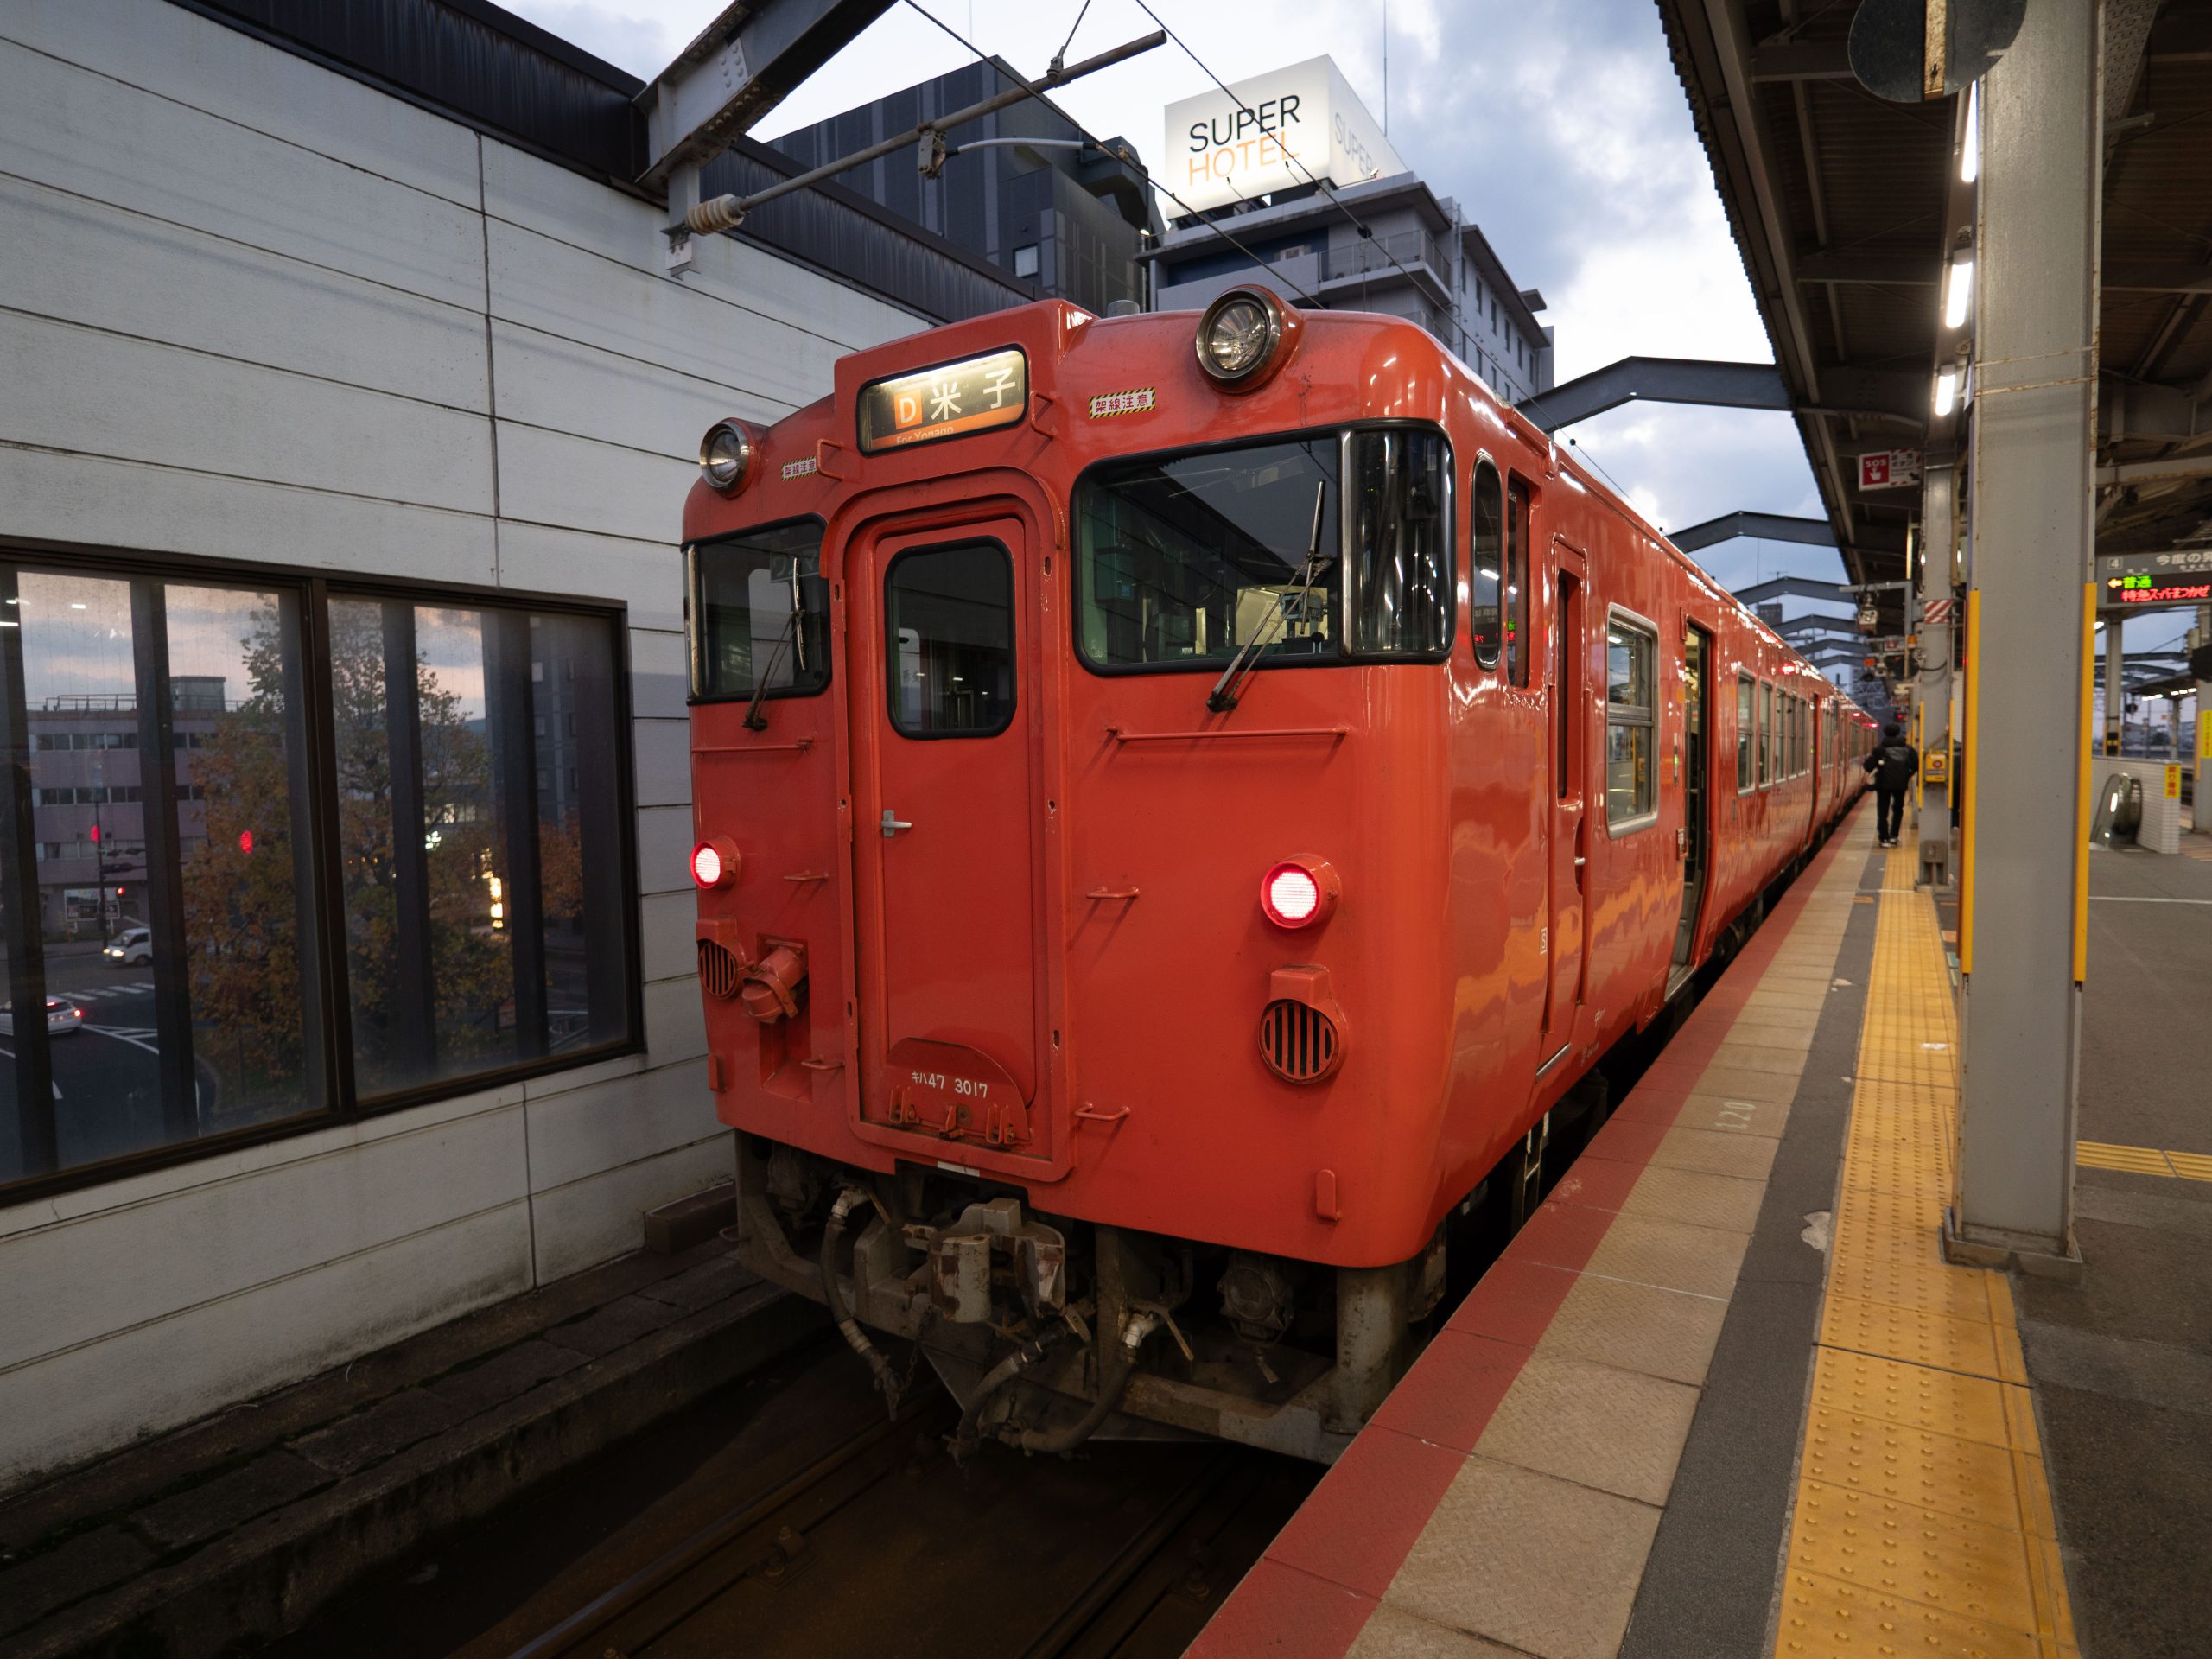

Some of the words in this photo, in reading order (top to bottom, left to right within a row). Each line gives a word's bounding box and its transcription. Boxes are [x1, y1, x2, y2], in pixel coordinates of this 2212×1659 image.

[1189, 94, 1300, 153] SUPER
[1189, 130, 1300, 186] HOTEL
[1335, 112, 1373, 178] SUPER
[899, 397, 916, 423] D
[930, 367, 1016, 420] 米子
[1095, 393, 1148, 413] 架線注意
[785, 461, 816, 477] 架線注意
[1866, 458, 1887, 468] SOS
[2110, 558, 2120, 569] 4
[912, 1071, 945, 1090] キハ47
[954, 1077, 988, 1098] 3017
